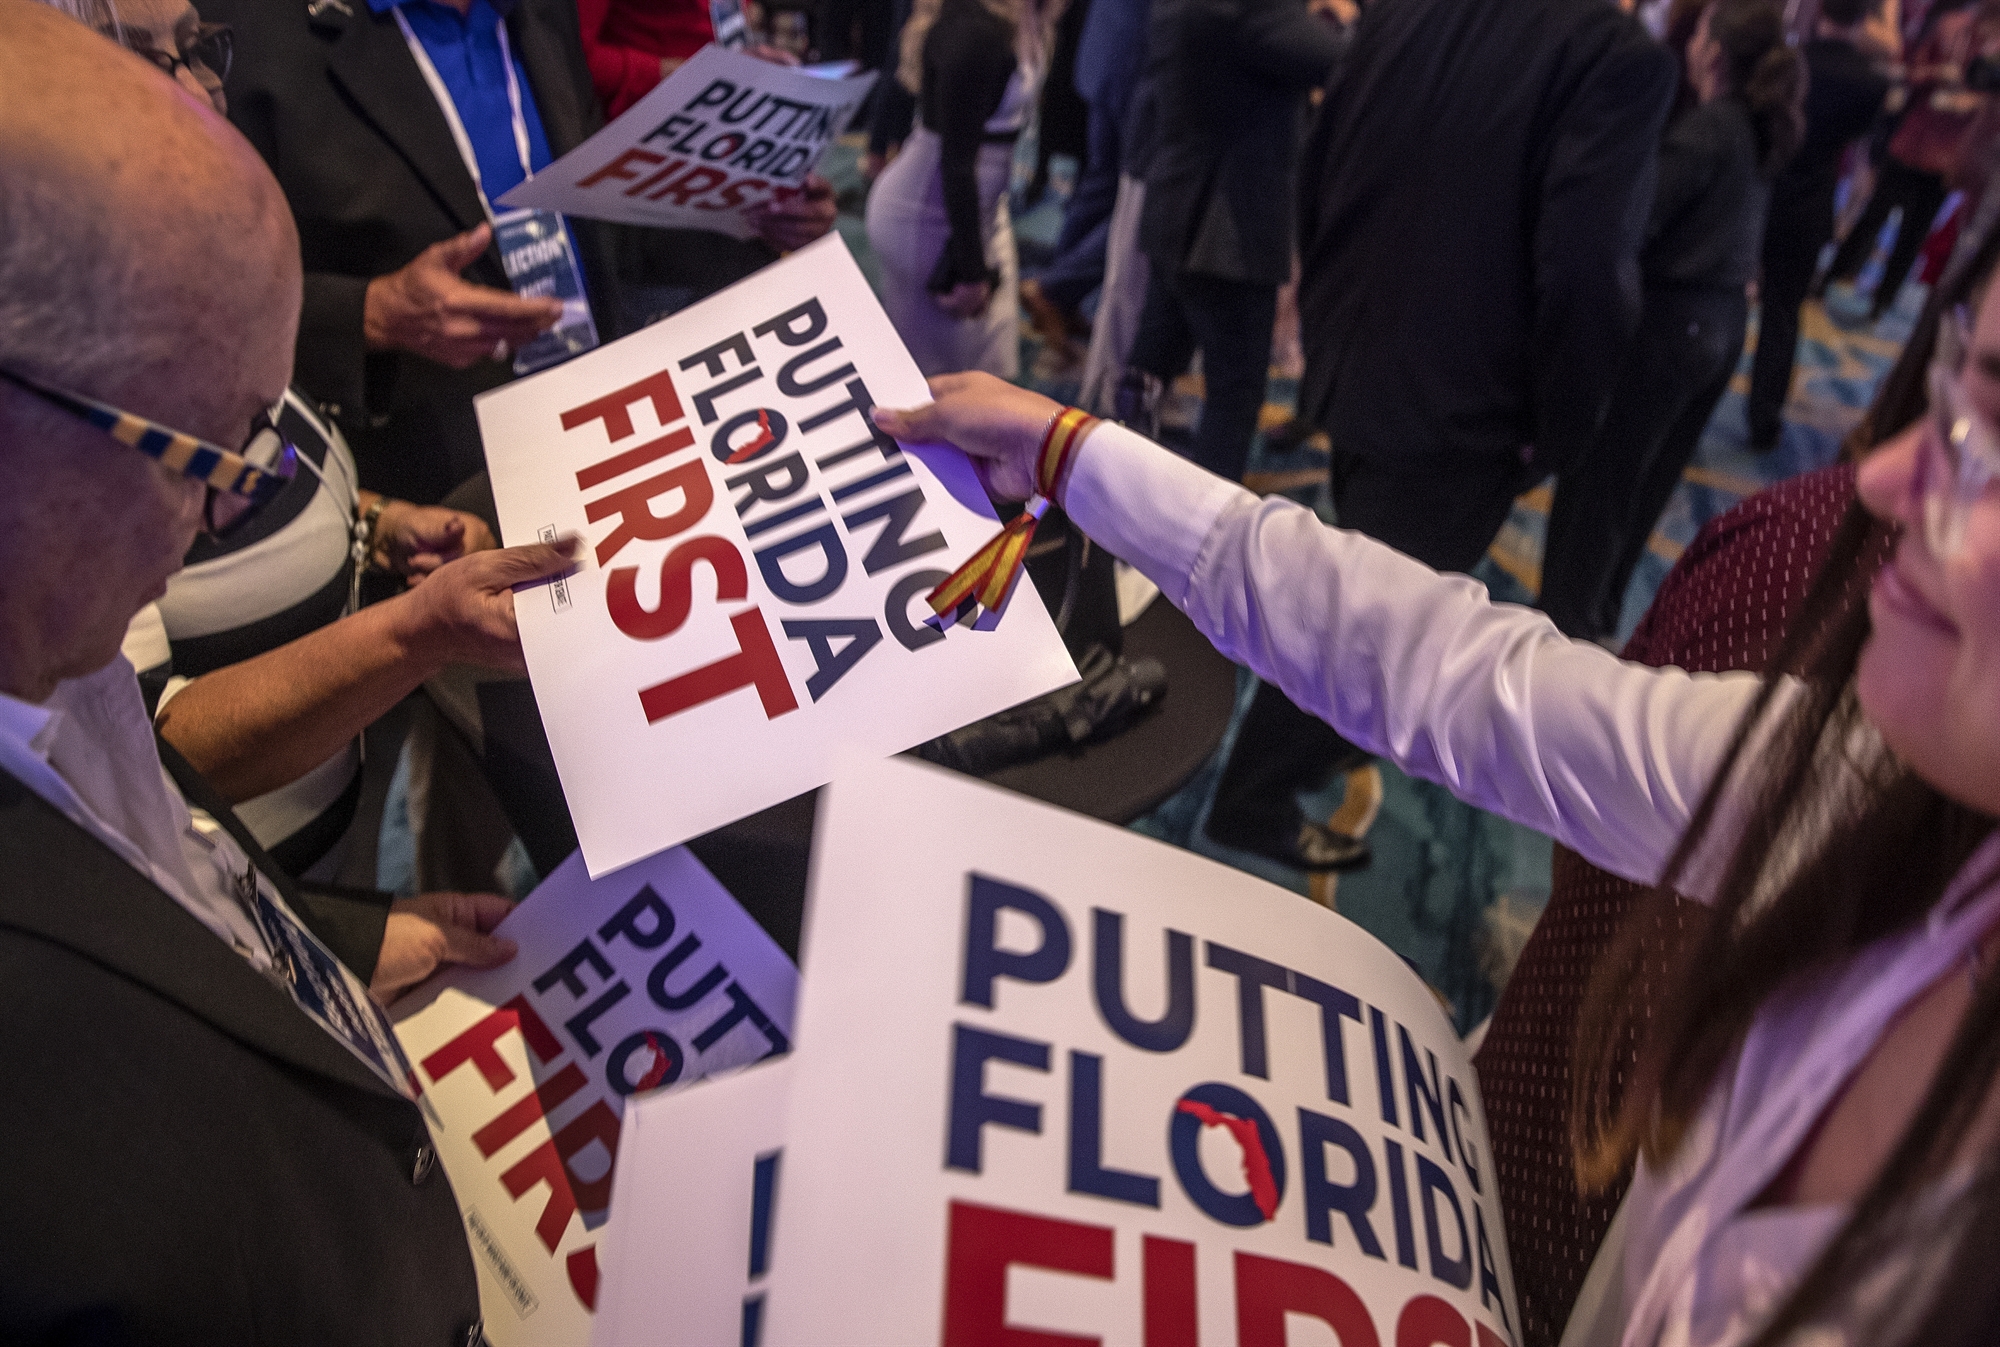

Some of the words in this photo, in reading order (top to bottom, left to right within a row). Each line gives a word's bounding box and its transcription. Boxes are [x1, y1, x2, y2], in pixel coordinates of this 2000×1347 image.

[641, 116, 811, 178] FLORID
[683, 78, 838, 140] PUTTIN
[559, 369, 799, 726] FIRST
[679, 332, 883, 704] FLORIDA
[752, 297, 979, 653] PUTTING
[420, 993, 622, 1315] FIR
[942, 1021, 1516, 1338] FLORIDA
[957, 870, 1483, 1197] PUTTING
